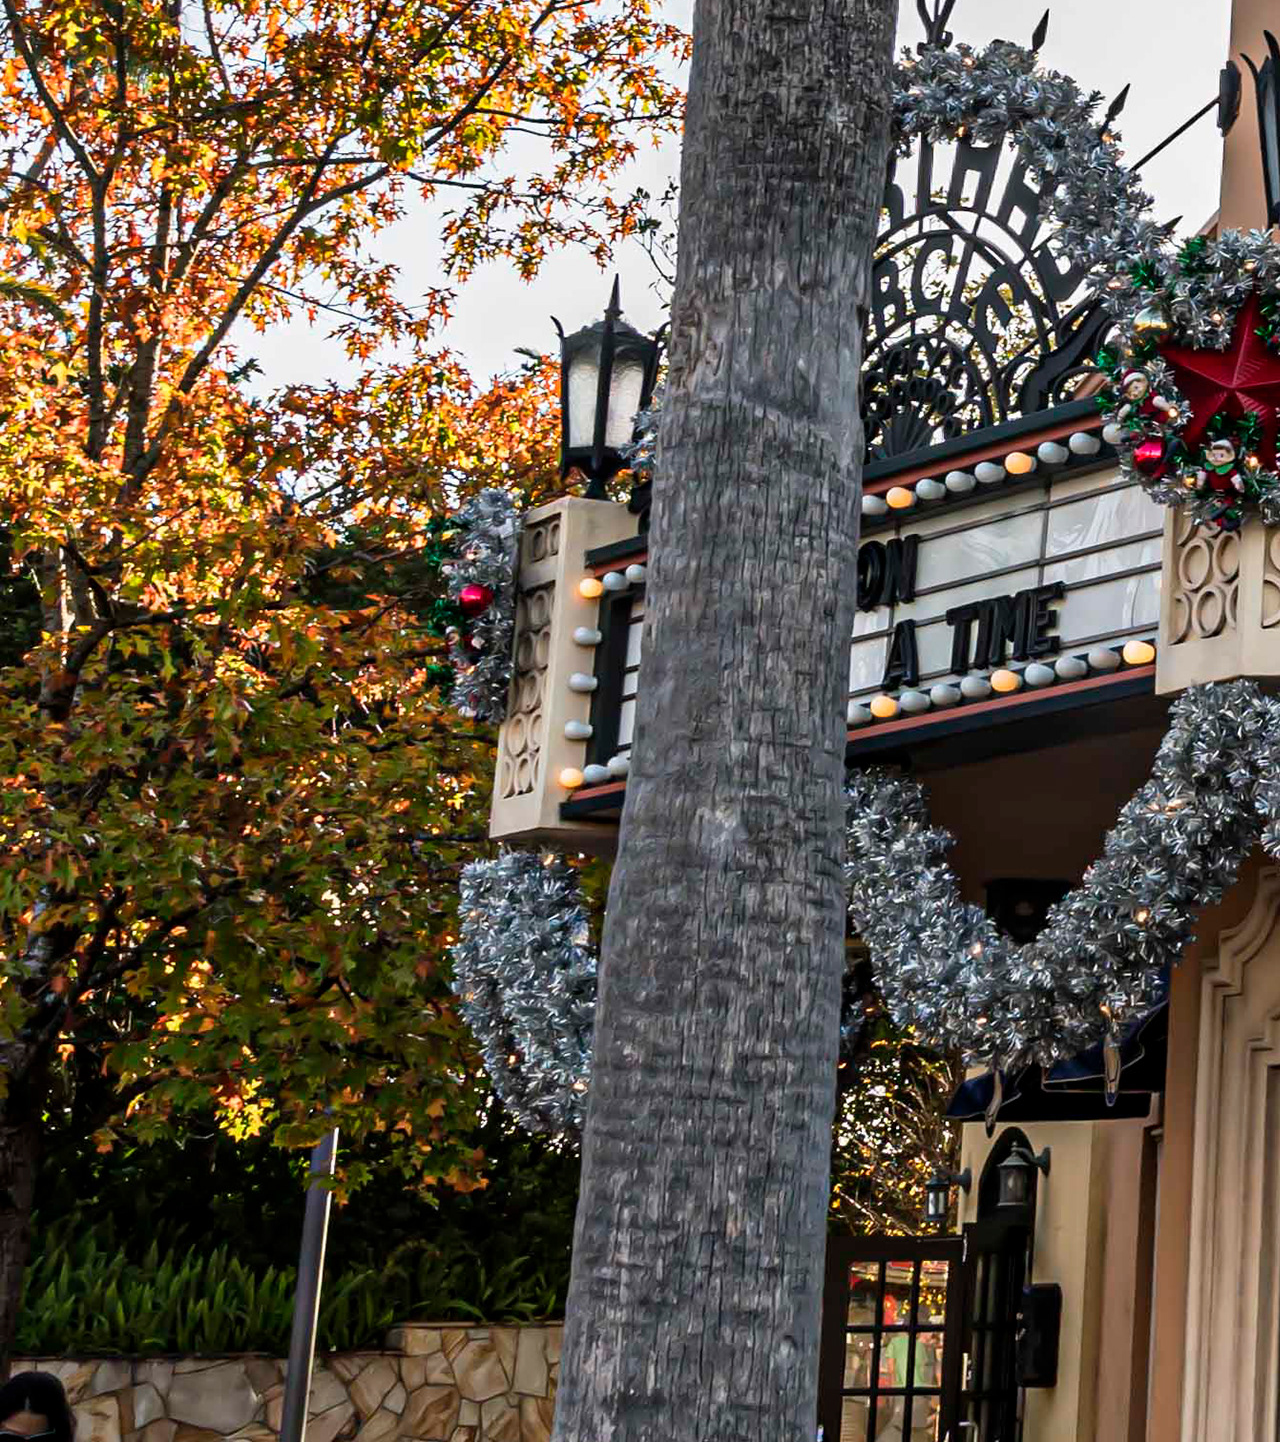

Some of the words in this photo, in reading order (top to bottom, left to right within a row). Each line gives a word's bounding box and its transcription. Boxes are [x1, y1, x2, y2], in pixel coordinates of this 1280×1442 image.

[856, 533, 922, 613] ON
[881, 619, 920, 692] A
[946, 580, 1066, 675] TIME
